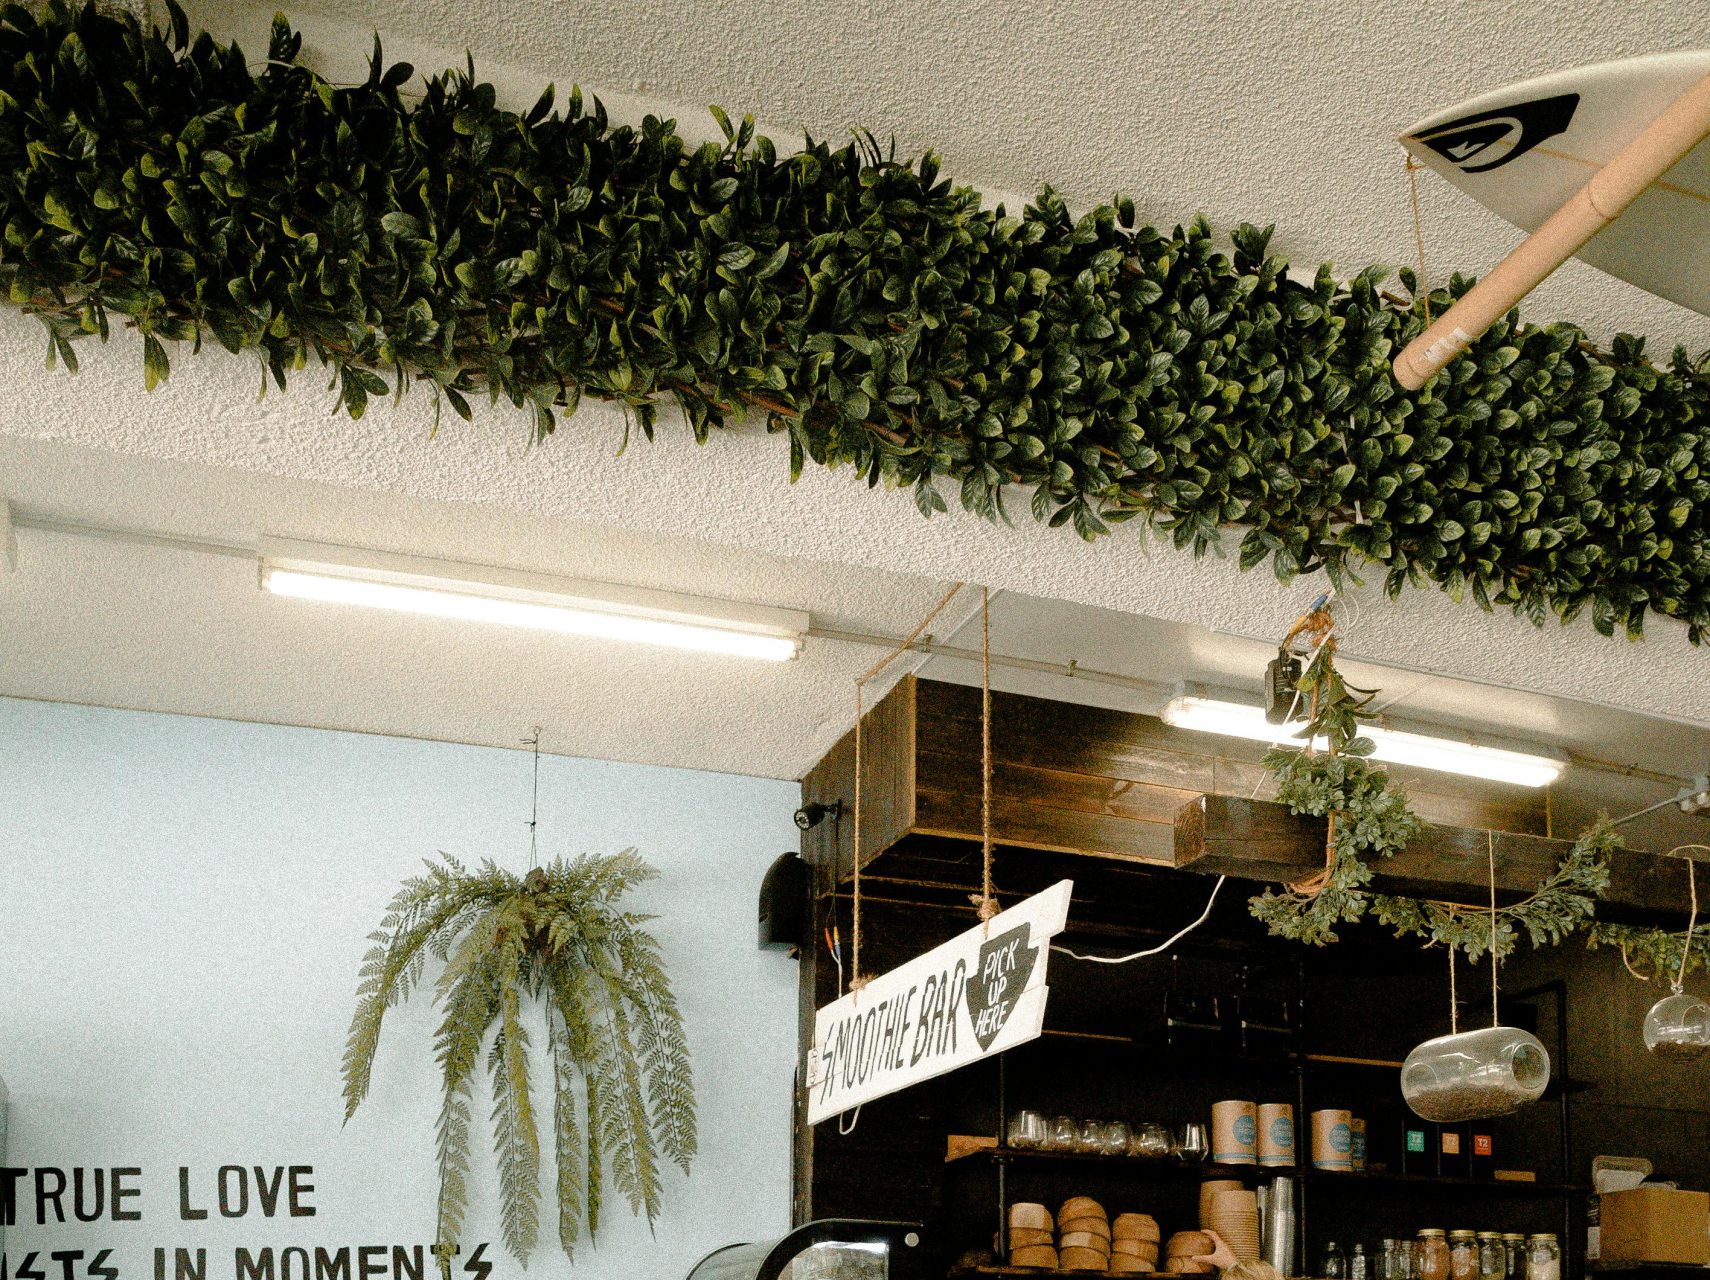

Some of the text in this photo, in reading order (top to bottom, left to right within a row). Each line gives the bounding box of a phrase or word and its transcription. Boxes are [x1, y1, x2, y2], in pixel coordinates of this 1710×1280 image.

[983, 938, 1019, 984] PICK
[988, 976, 1007, 1006] UP
[820, 958, 966, 1104] SMOOTHIE BAR
[975, 1001, 1009, 1038] HERE
[0, 1165, 316, 1226] TRUE LOVE
